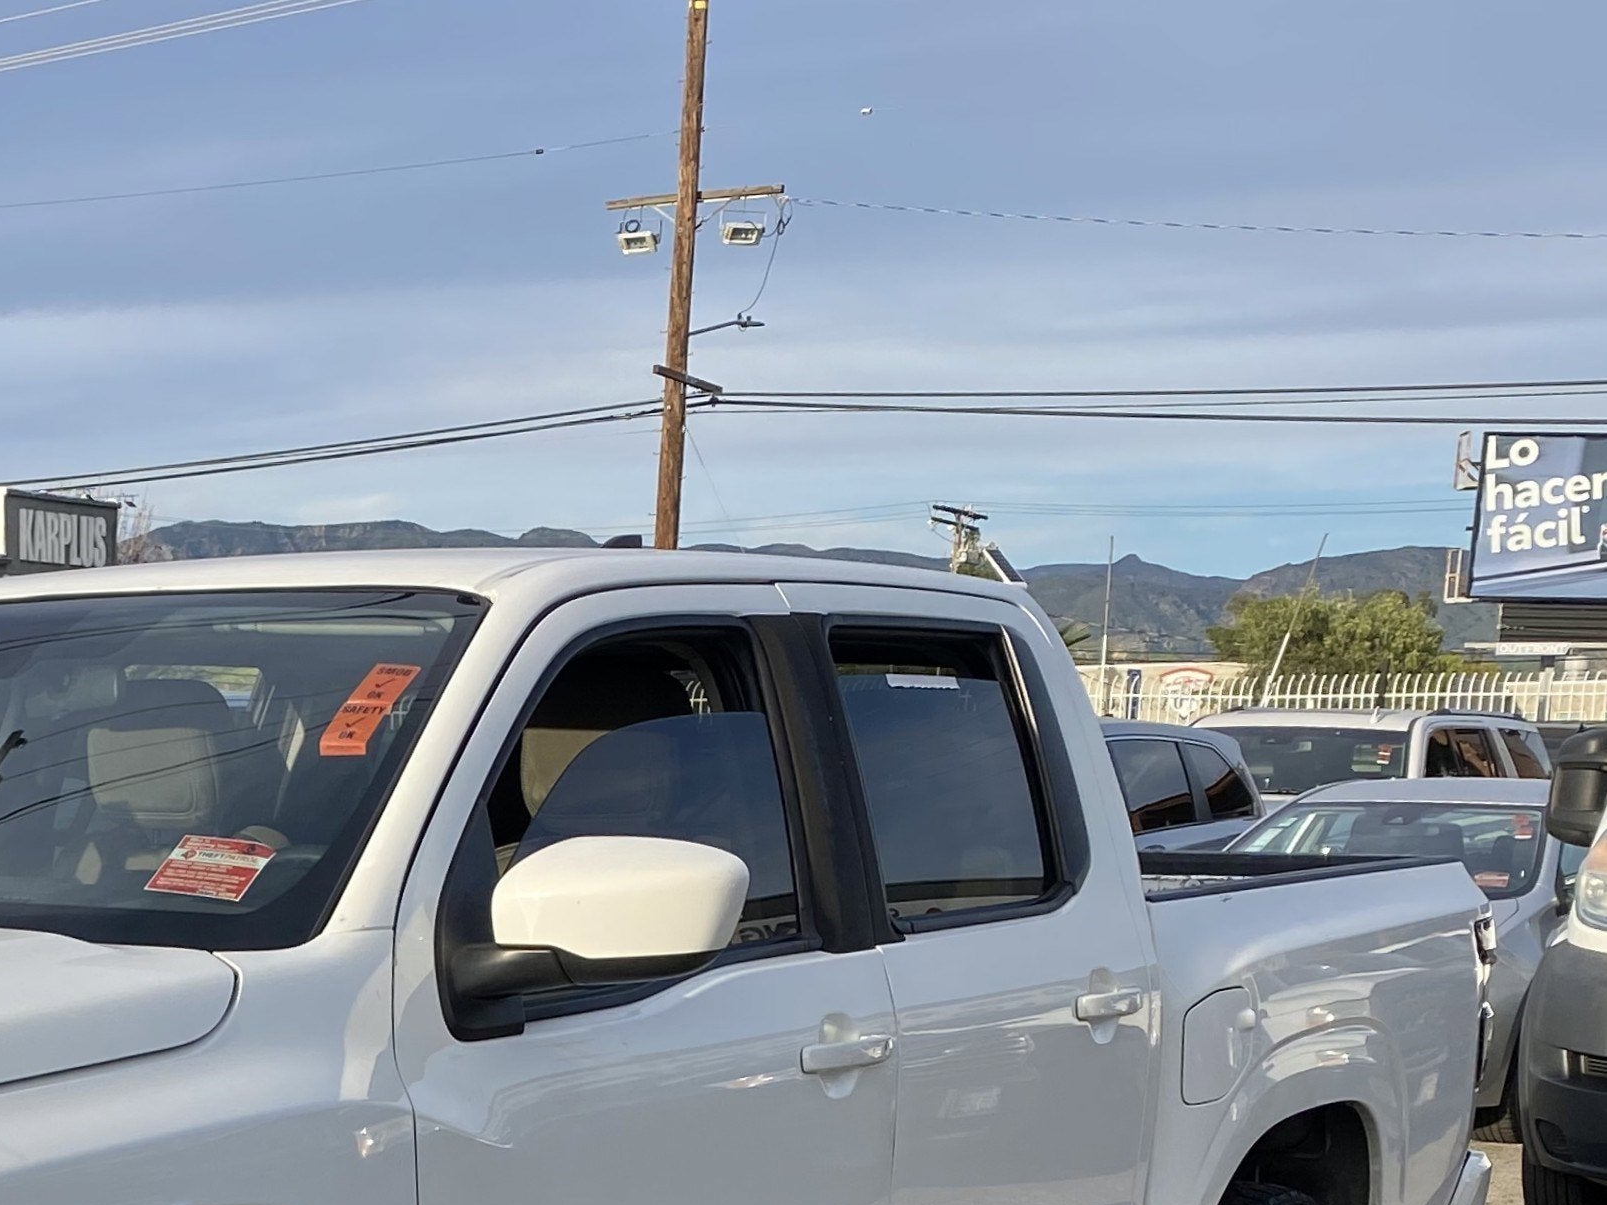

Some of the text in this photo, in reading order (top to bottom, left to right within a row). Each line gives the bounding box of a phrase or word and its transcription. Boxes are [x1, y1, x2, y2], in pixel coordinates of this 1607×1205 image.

[1486, 435, 1540, 470] Lo
[1485, 471, 1607, 512] hacer
[19, 508, 107, 568] KARPLUS
[1486, 505, 1586, 554] fácil
[341, 705, 388, 715] SAFETY
